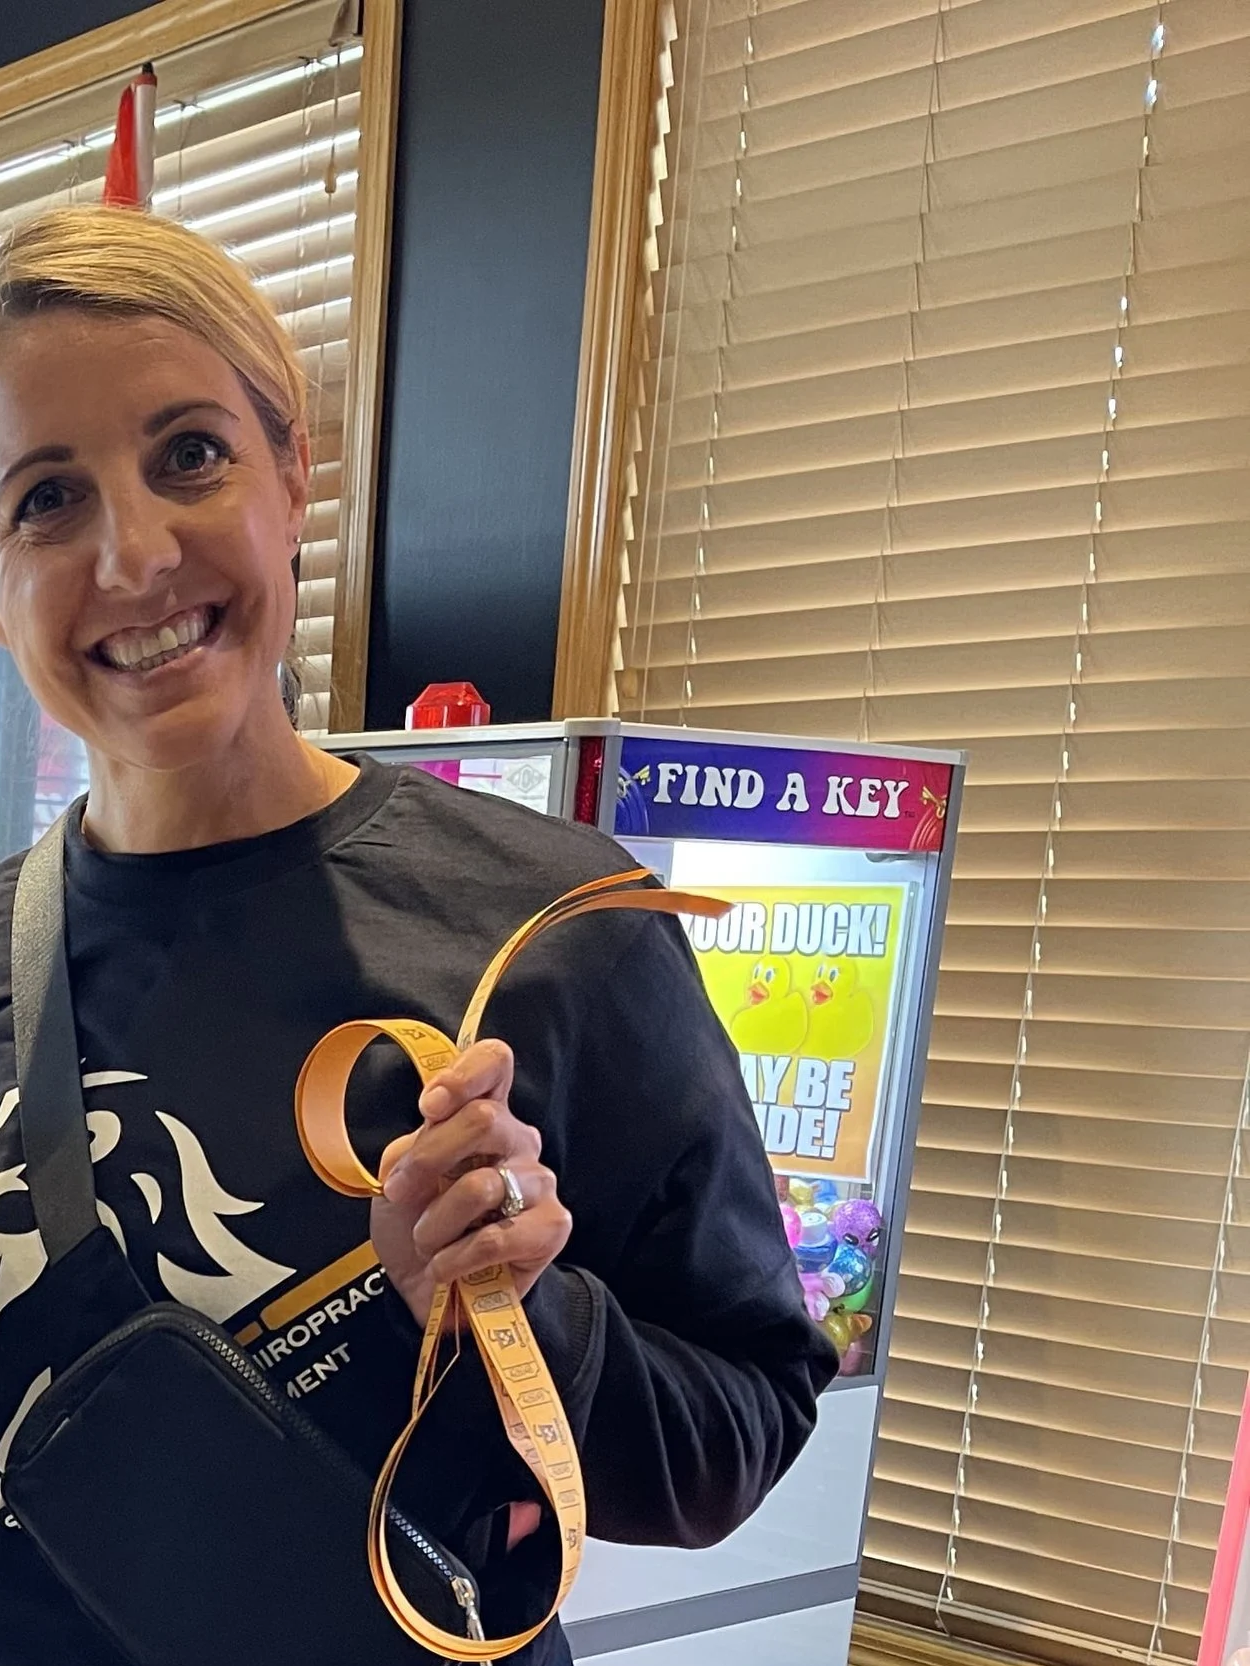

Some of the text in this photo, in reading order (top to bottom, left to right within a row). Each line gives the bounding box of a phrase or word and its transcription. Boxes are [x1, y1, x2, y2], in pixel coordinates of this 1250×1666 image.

[653, 762, 910, 819] FIND A KEY
[770, 902, 891, 958] DUCK!
[793, 1057, 856, 1112] BE
